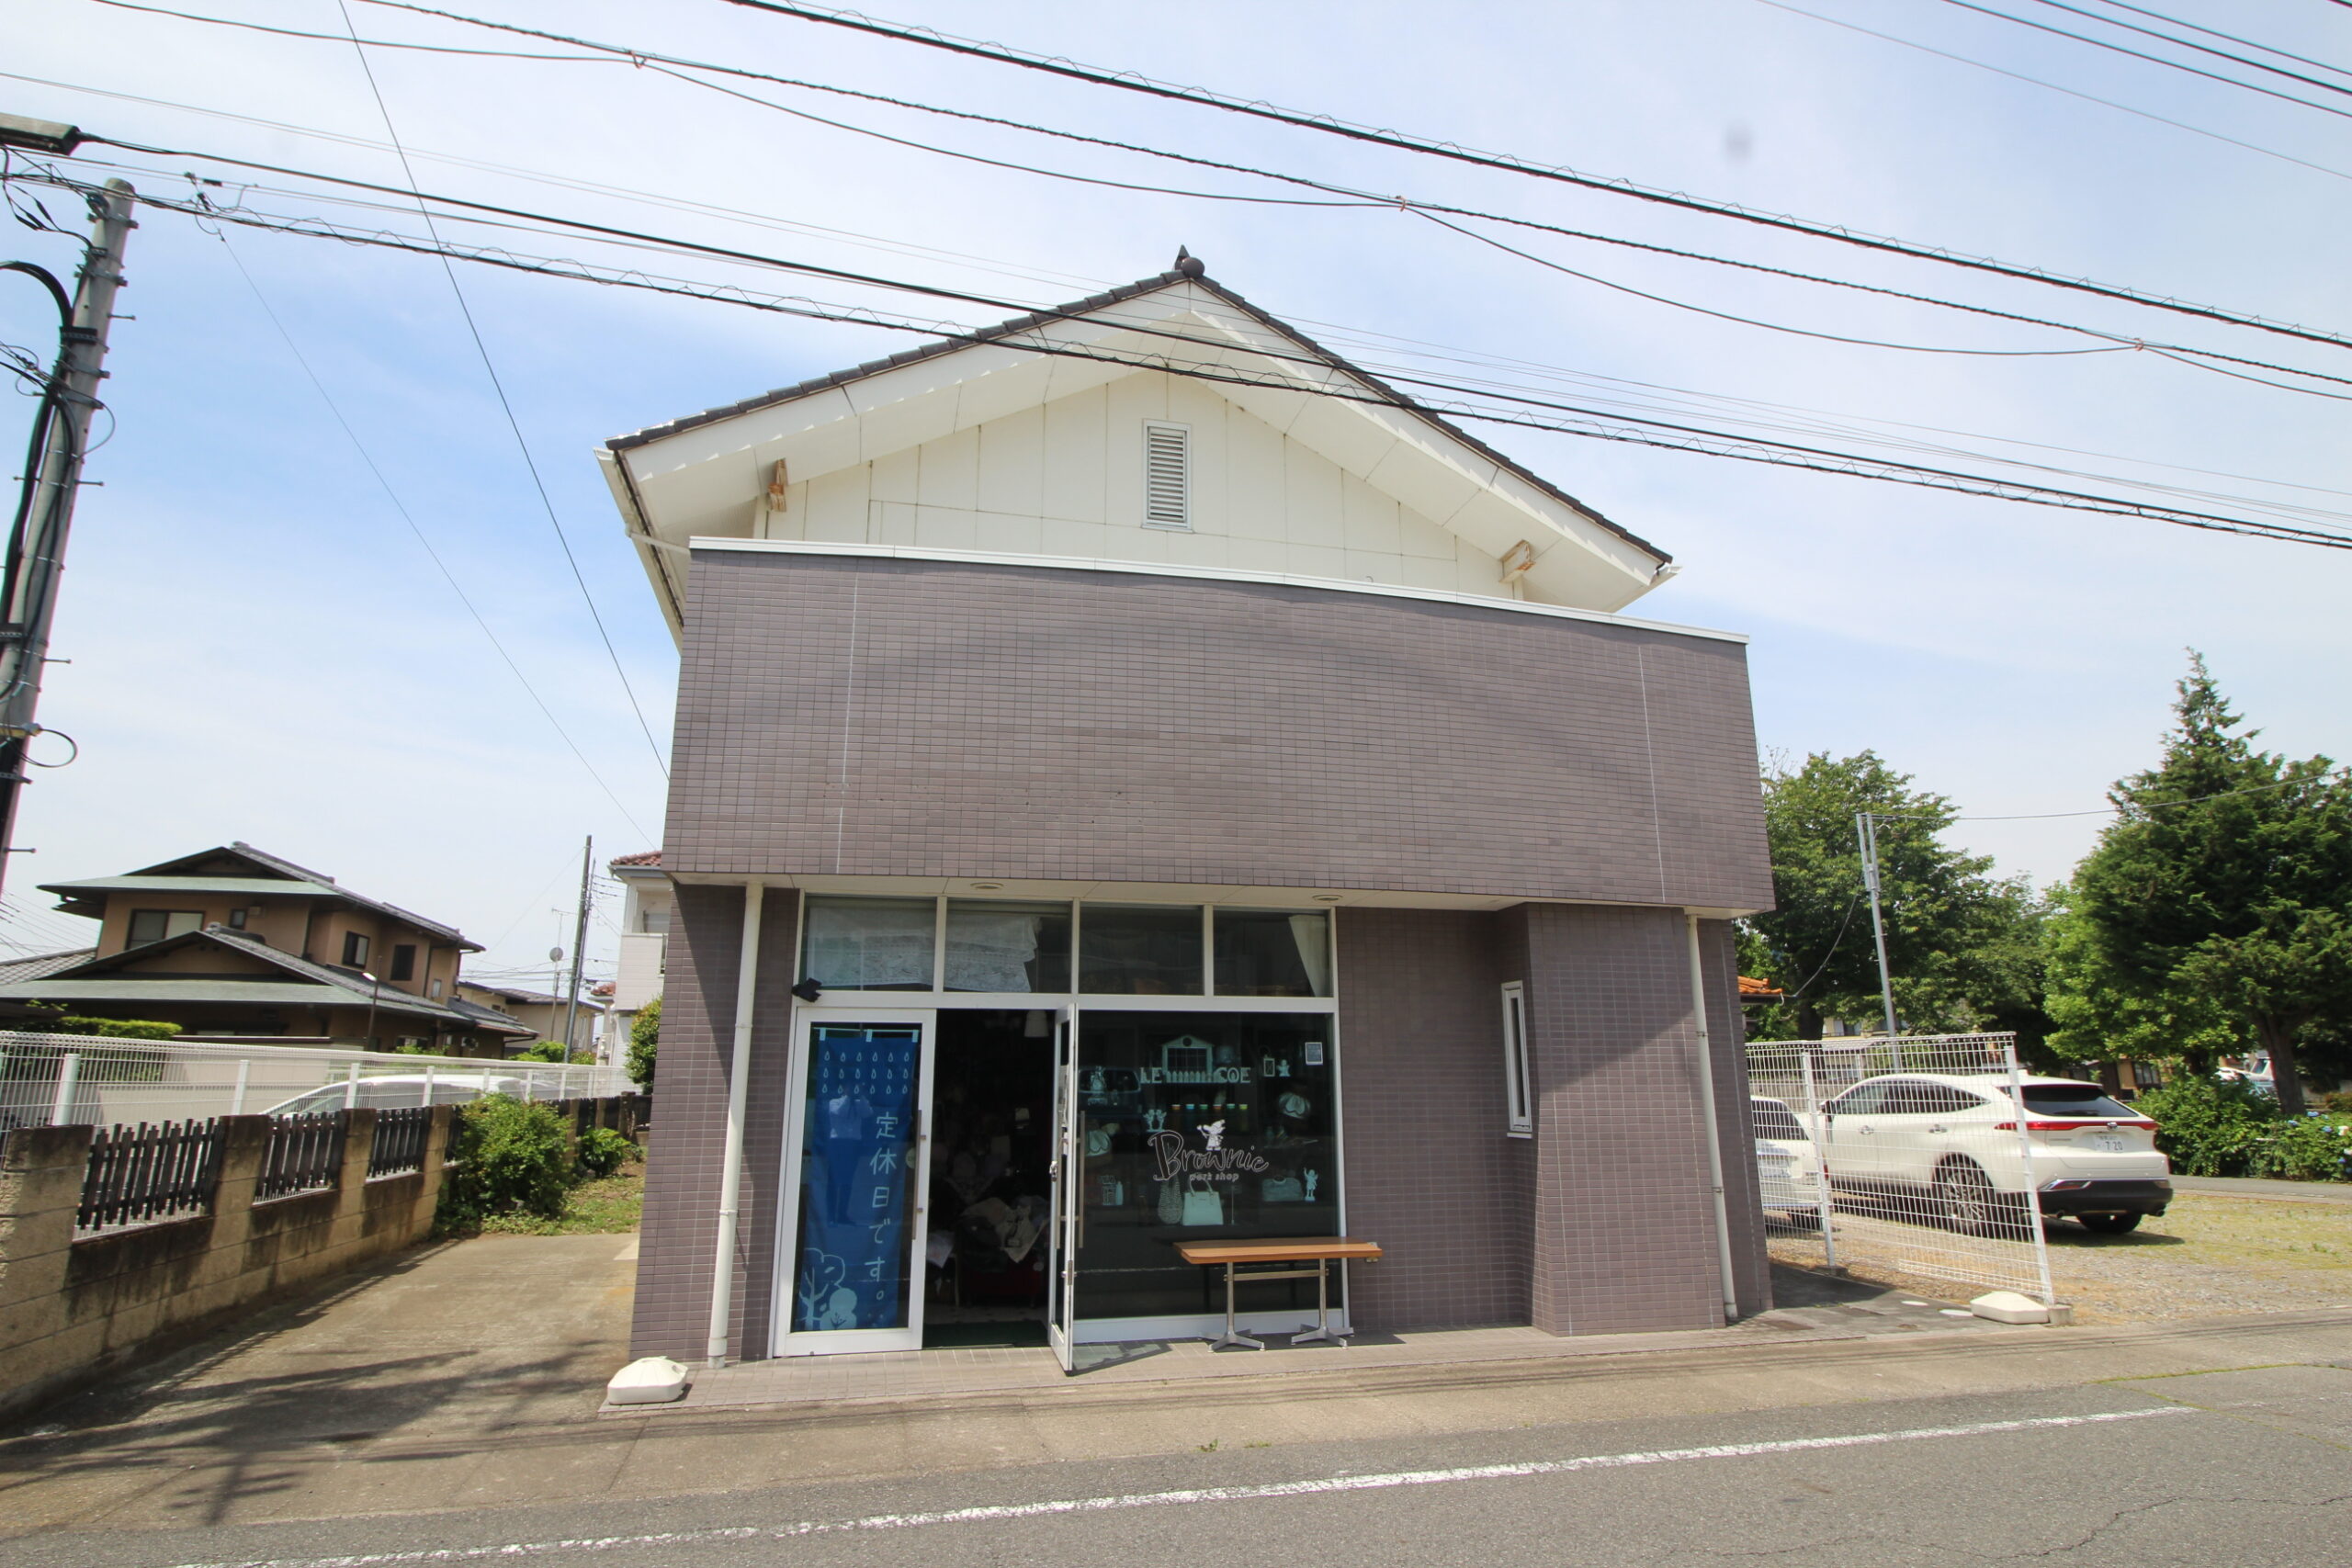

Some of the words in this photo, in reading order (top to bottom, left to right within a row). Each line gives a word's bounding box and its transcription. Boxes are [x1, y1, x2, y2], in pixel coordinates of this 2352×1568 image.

[1148, 1129, 1270, 1181] Brownie
[1215, 1171, 1239, 1183] shop
[865, 1111, 899, 1301] 定休日です。
